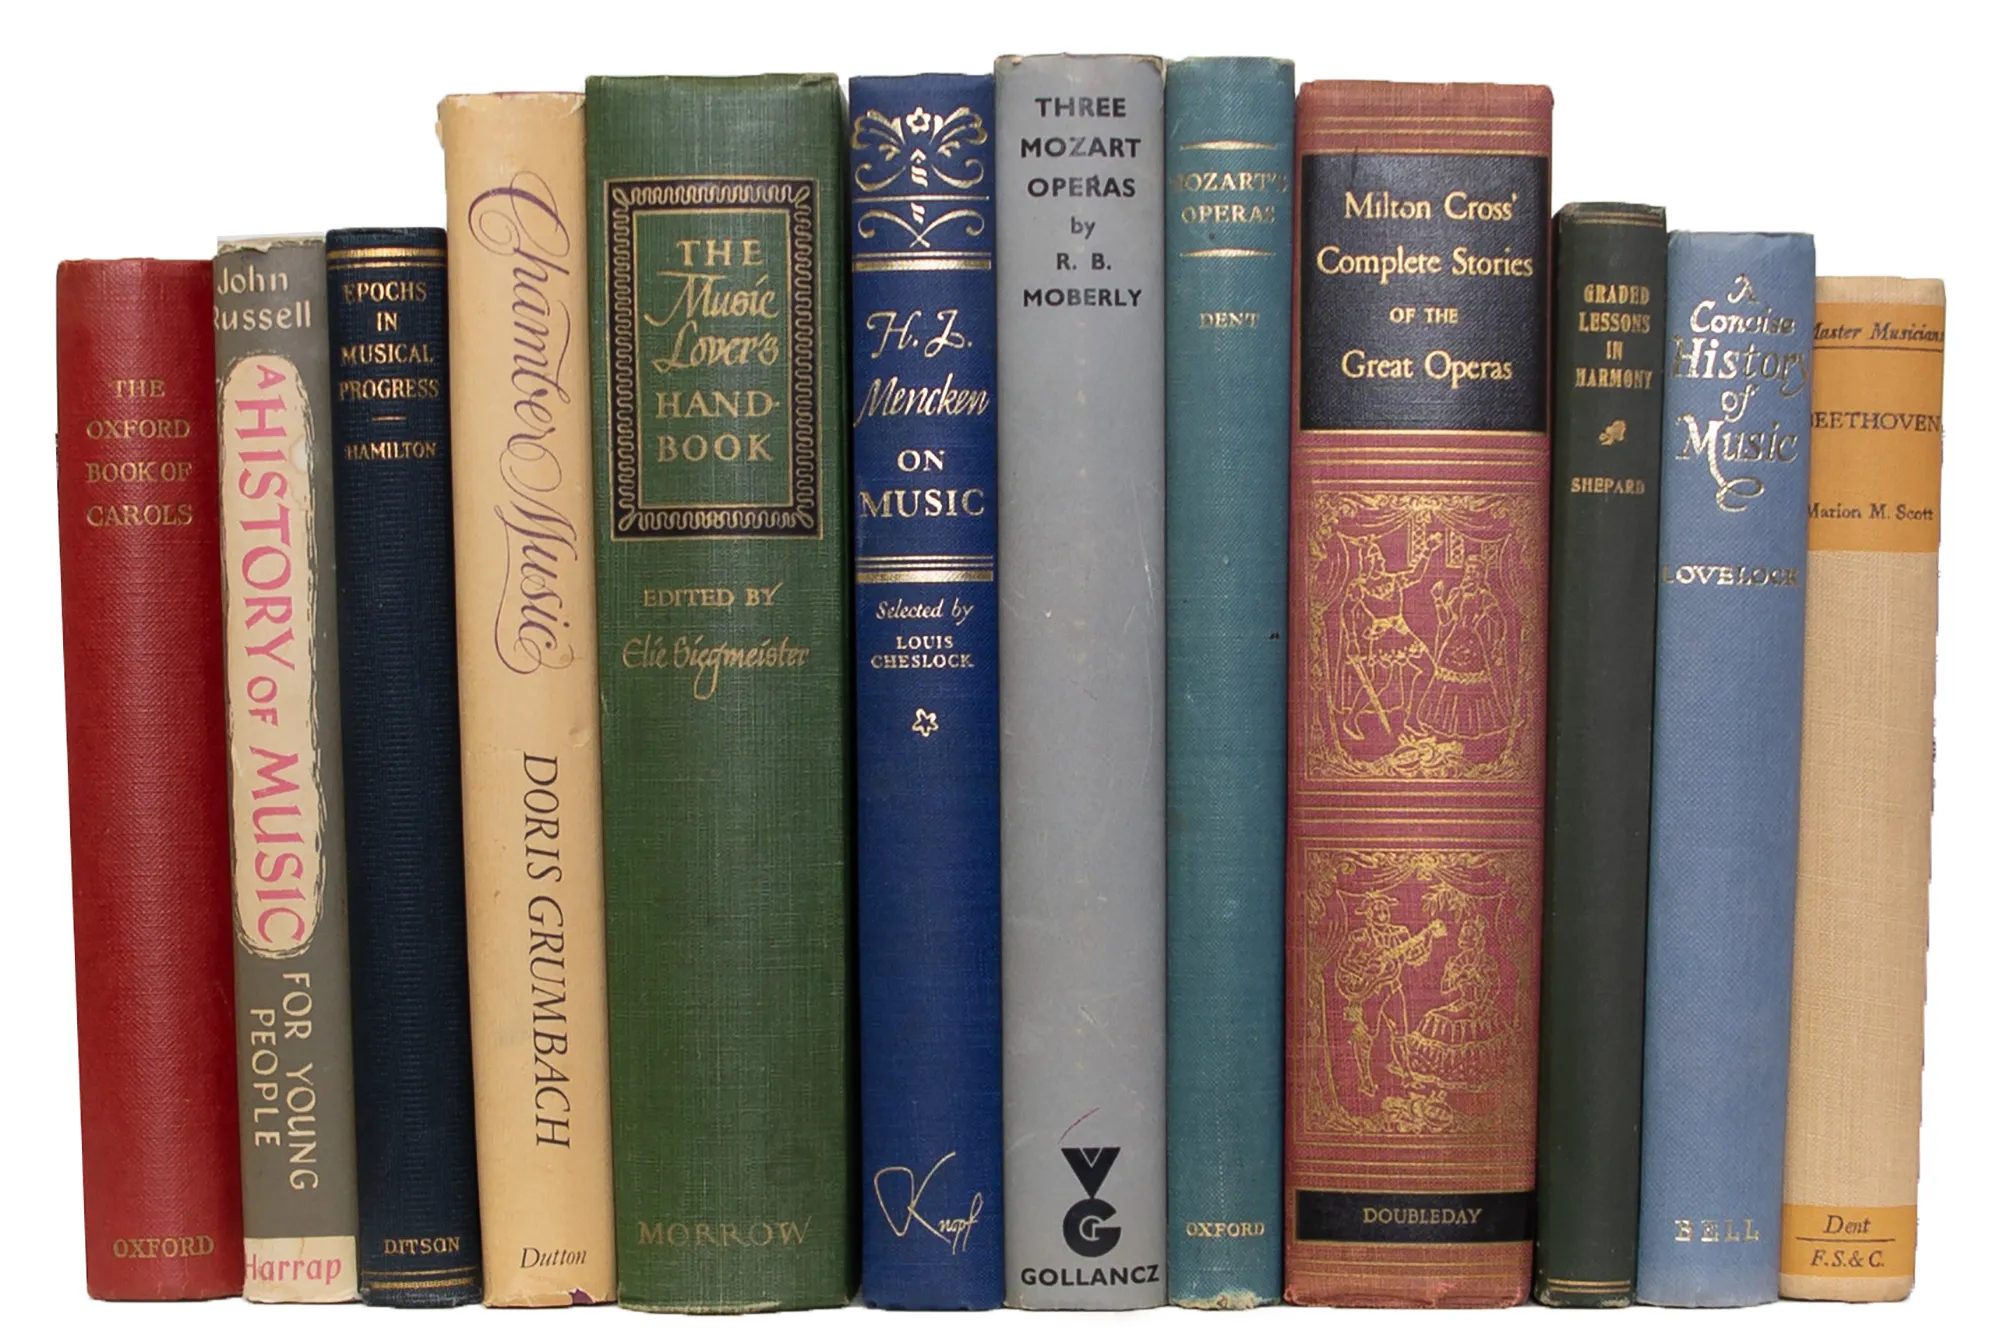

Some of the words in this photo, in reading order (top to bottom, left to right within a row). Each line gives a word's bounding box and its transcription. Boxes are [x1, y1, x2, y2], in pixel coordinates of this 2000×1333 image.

[1034, 97, 1127, 118] THREE
[1020, 136, 1141, 159] MOZART
[1027, 176, 1136, 198] OPERAS
[1343, 191, 1432, 220] Milton
[1443, 191, 1518, 221] Cross'
[1070, 216, 1096, 240] by
[676, 239, 765, 267] THE
[1056, 252, 1077, 271] R.
[1091, 252, 1112, 271] B.
[1316, 244, 1442, 286] Complete
[1451, 246, 1534, 277] Stories
[217, 264, 288, 295] John
[343, 281, 428, 302] EPOCHS
[1727, 273, 1758, 305] A
[643, 270, 781, 327] Music
[1023, 288, 1143, 308] MOBERLY
[1583, 283, 1651, 305] GRADED
[375, 311, 398, 332] IN
[468, 171, 571, 478] Chamber
[1199, 311, 1260, 330] DENT
[1389, 306, 1416, 325] OF
[1423, 307, 1460, 325] THE
[1578, 311, 1651, 334] LESSONS
[1689, 300, 1796, 336] Concise
[866, 309, 922, 360] H.
[923, 308, 973, 359] L.
[340, 342, 434, 365] MUSICAL
[650, 320, 780, 374] Lover's
[1605, 340, 1624, 361] IN
[256, 364, 287, 390] A
[1341, 349, 1414, 379] Great
[1424, 350, 1513, 391] Operas
[1575, 367, 1653, 389] HARMONY
[1672, 333, 1809, 399] History
[111, 379, 165, 399] THE
[339, 377, 440, 401] PROGRESS
[853, 372, 990, 428] Mencken
[1720, 383, 1760, 423] of
[86, 419, 190, 440] OXFORD
[1811, 411, 1942, 433] EETHOVEN
[345, 441, 437, 461] HAMILTON
[656, 432, 775, 463] BOOK
[86, 462, 155, 484] BOOK
[159, 462, 192, 483] OF
[896, 449, 945, 473] ON
[1675, 413, 1800, 514] Music
[1570, 476, 1645, 495] SHEPARD
[86, 504, 193, 526] CAROLS
[859, 488, 985, 519] MUSIC
[1868, 502, 1891, 519] M.
[1895, 503, 1934, 521] Scott
[233, 397, 296, 671] HISTORY
[494, 494, 584, 675] Music
[1662, 564, 1802, 587] LOVELOCK
[643, 587, 735, 608] EDITED
[745, 581, 784, 608] BY
[875, 598, 945, 620] Selected
[951, 597, 975, 626] by
[622, 633, 669, 669] Elie
[896, 635, 954, 650] LOUIS
[870, 653, 975, 669] CHESLOCK
[246, 675, 279, 728] OF
[523, 751, 563, 884] DORIS
[249, 745, 306, 944] MUSIC
[282, 972, 313, 1040] FOR
[526, 894, 571, 1149] GRUMBACH
[249, 1008, 281, 1148] PEOPLE
[283, 1062, 319, 1191] YOUNG
[873, 1151, 984, 1256] Knopf
[1362, 1206, 1483, 1226] DOUBLEDAY
[1822, 1213, 1872, 1235] Dent
[637, 1215, 812, 1248] MORROW
[1185, 1221, 1265, 1238] OXFORD
[1673, 1218, 1760, 1243] BELL
[112, 1235, 215, 1259] OXFORD
[383, 1236, 461, 1256] DITSON
[519, 1246, 587, 1270] Dutton
[245, 1253, 342, 1285] Harrap
[1020, 1264, 1161, 1287] GOLLANCZ
